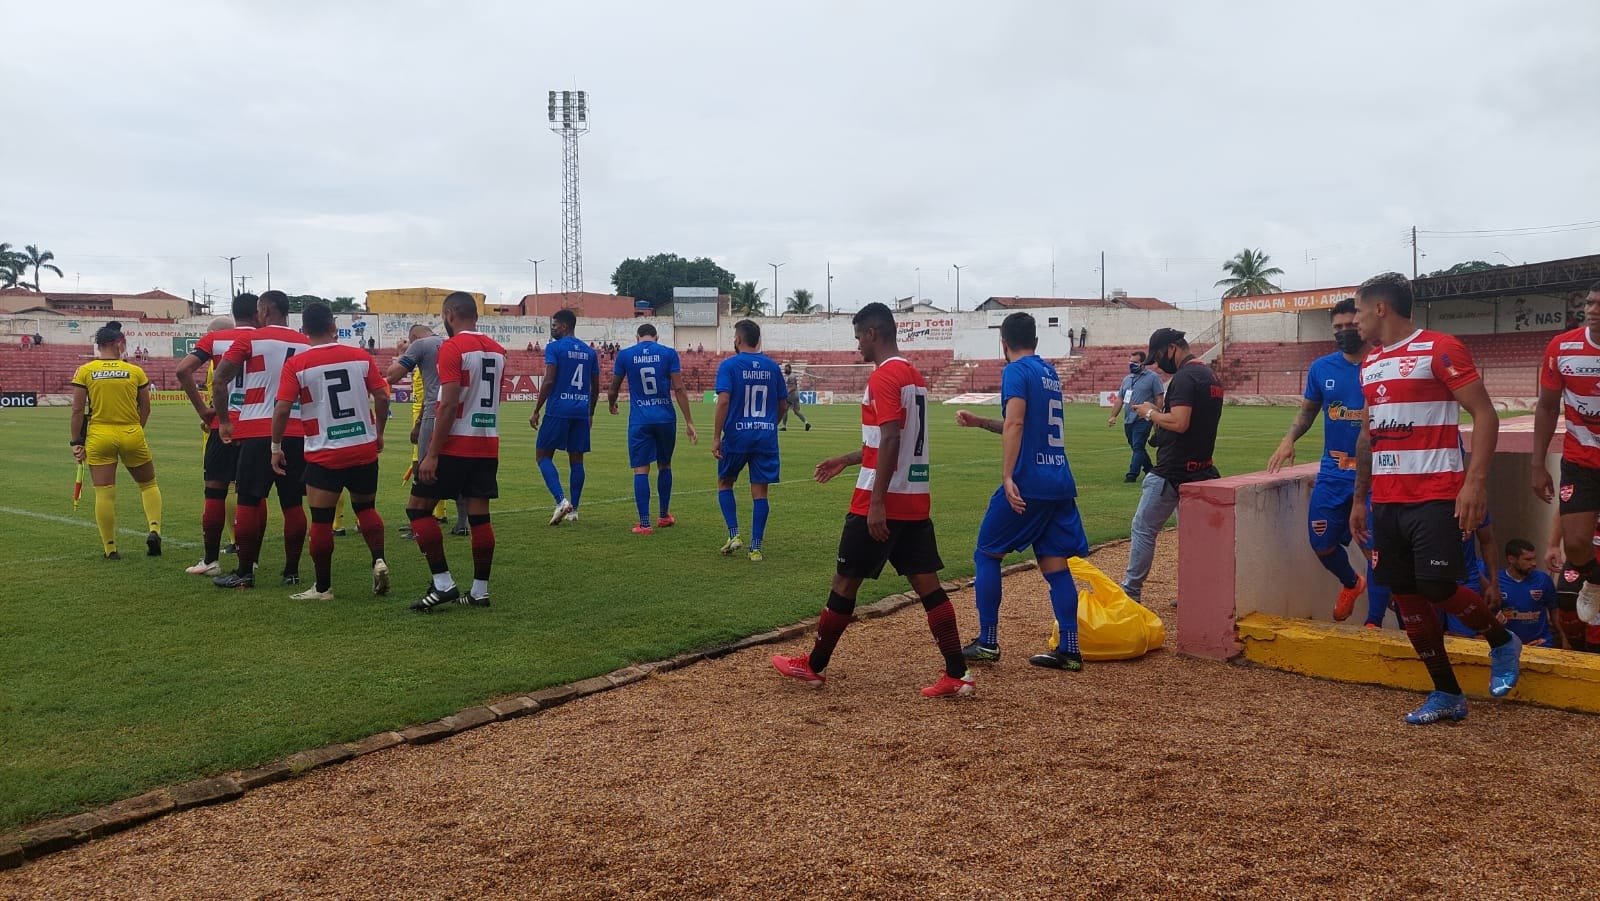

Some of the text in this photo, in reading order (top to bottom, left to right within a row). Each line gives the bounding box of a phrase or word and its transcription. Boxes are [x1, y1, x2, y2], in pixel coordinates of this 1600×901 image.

[1272, 299, 1286, 309] FM
[1294, 296, 1315, 307] 107,1
[1320, 295, 1329, 305] A
[924, 319, 953, 327] Total
[1535, 311, 1562, 325] NAS
[499, 325, 545, 334] MUNICIPAL
[633, 354, 660, 364] BARUERI
[91, 370, 129, 378] VEDACIT
[570, 363, 584, 391] 4
[639, 366, 658, 395] 6
[742, 370, 771, 380] BARUERI
[481, 358, 496, 408] 5
[0, 394, 34, 406] onic
[150, 393, 190, 401] Alternati
[324, 368, 356, 420] 2
[507, 393, 539, 401] LINENSE
[743, 384, 768, 418] 10
[1047, 398, 1065, 447] 5
